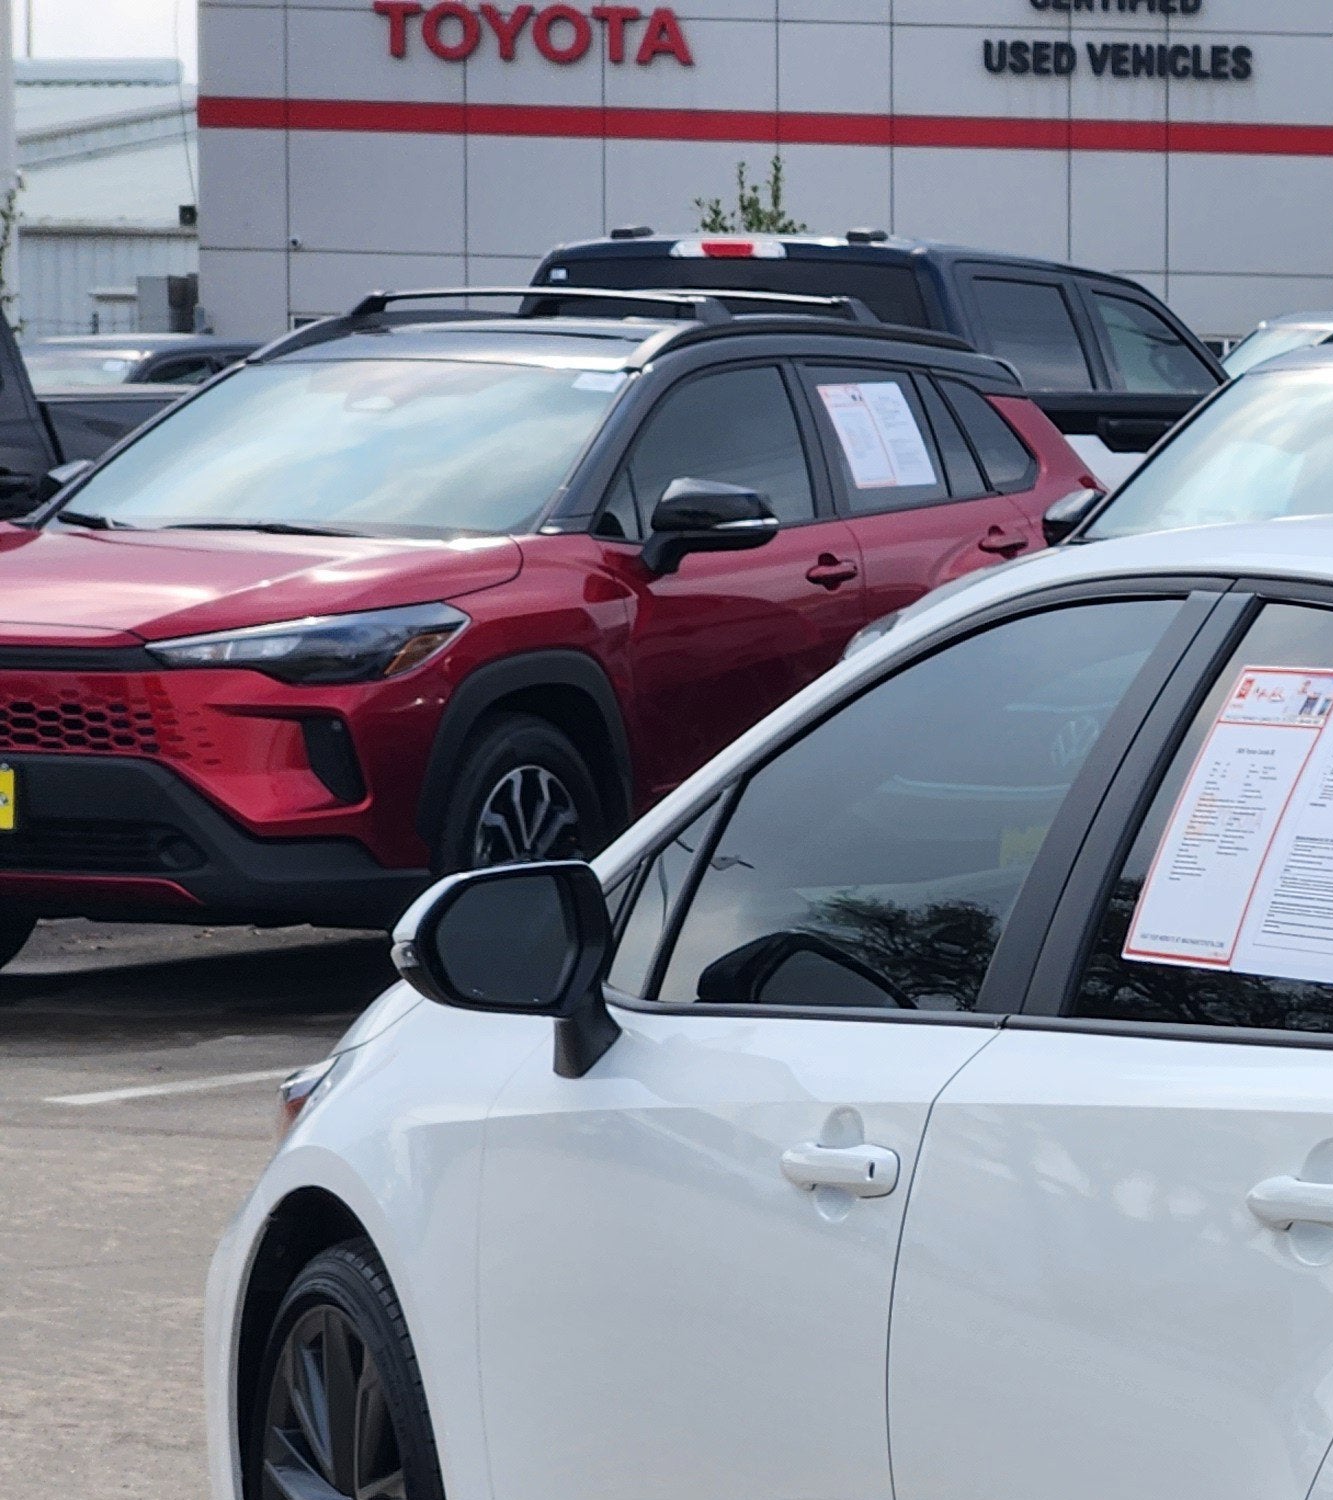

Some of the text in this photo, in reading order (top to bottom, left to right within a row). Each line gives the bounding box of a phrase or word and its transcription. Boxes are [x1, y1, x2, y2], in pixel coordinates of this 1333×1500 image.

[372, 1, 696, 67] TOYOTA
[983, 39, 1253, 80] USED VEHICLES
